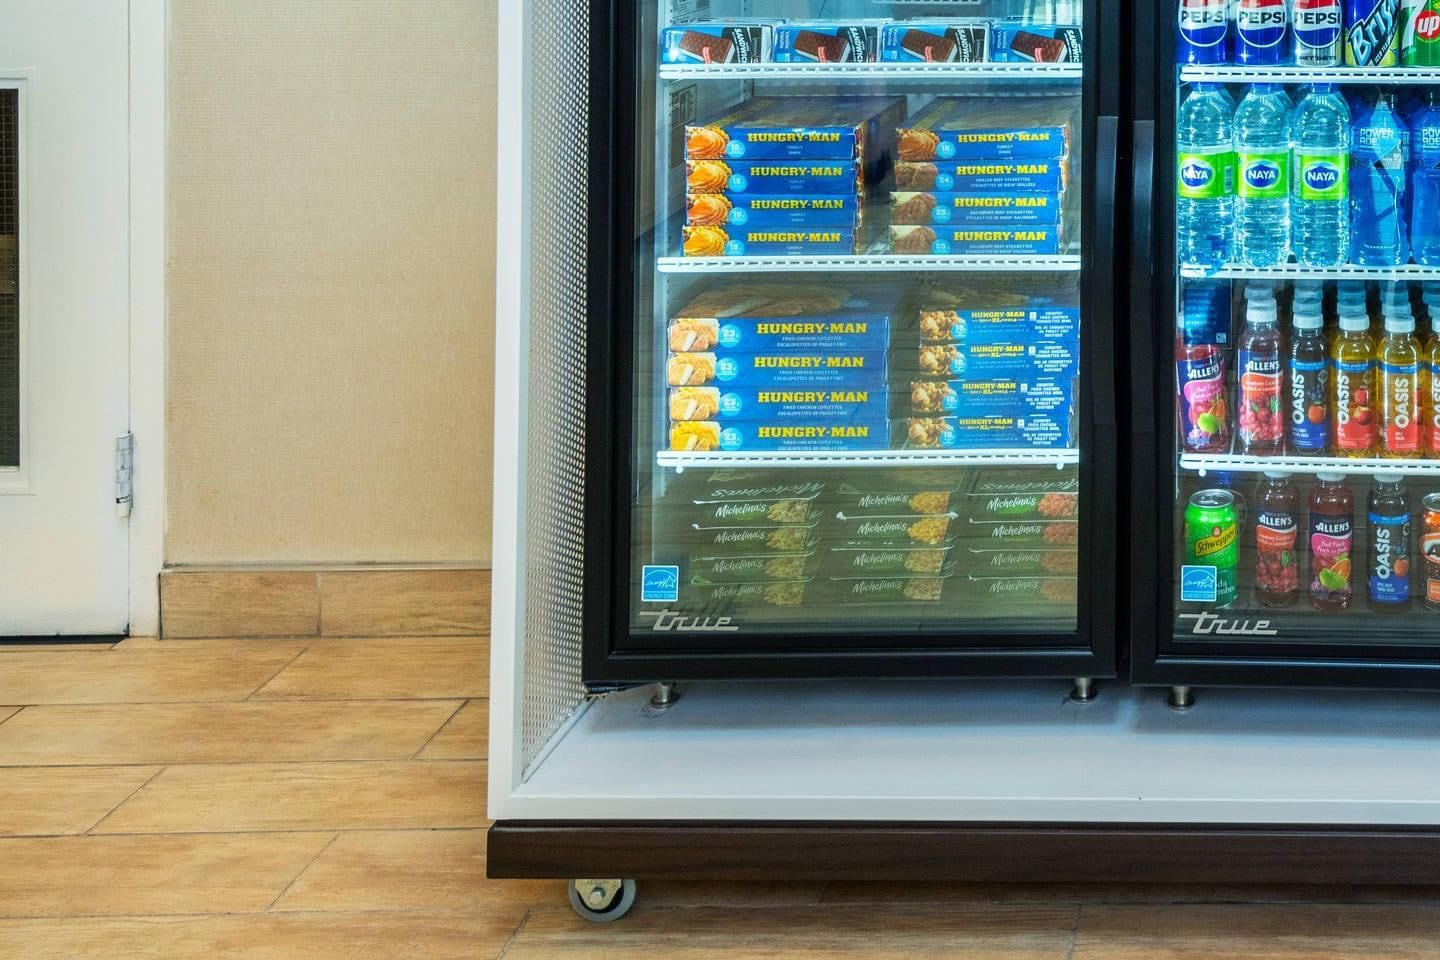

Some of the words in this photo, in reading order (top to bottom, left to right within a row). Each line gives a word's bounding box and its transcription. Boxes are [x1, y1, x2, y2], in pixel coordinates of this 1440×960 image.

[1239, 11, 1286, 24] PEPSI
[1294, 11, 1341, 25] PEPSI
[1417, 14, 1440, 36] up
[748, 132, 840, 142] HUNGRY-MAN
[957, 133, 1050, 143] HUNGRY-MAN
[1360, 128, 1395, 139] POWER
[750, 167, 842, 176] HUNGRY-MAN
[956, 165, 1048, 175] HUNGRY-MAN
[1183, 171, 1209, 180] NAYA
[1248, 170, 1276, 180] NAYA
[1307, 171, 1336, 181] NAYA
[751, 200, 843, 209] HUNGRY-MAN
[954, 197, 1048, 207] HUNGRY-MAN
[748, 233, 841, 242] HUNGRY-MAN
[953, 231, 1047, 241] HUNGRY-MAN
[971, 311, 1025, 319] HUNGRY-MAN
[757, 323, 868, 334] HUNGRY-MAN
[970, 346, 1024, 354] HUNGRY-MAN
[754, 357, 865, 368] HUNGRY-MAN
[1247, 360, 1280, 371] ALLEN'S
[757, 392, 868, 403] HUNGRY-MAN
[1291, 374, 1305, 425] OASIS
[1337, 375, 1350, 425] OASIS
[1394, 378, 1409, 429] OASIS
[758, 427, 869, 438] HUNGRY-MAN
[858, 494, 909, 509] Michelina's
[986, 496, 1037, 513] Michelina's
[716, 503, 767, 518] Michelina's
[1259, 515, 1292, 526] ALLEN'S
[857, 522, 908, 536] Michelina's
[991, 524, 1042, 539] Michelina's
[1315, 521, 1350, 533] ALLEN'S
[714, 530, 767, 545] Michelina's
[853, 551, 904, 567] Michelina's
[990, 552, 1041, 566] Michelina's
[1376, 528, 1391, 580] OASIS
[712, 559, 763, 573] Michelina's
[852, 580, 903, 594] Michelina's
[989, 579, 1039, 594] Michelina's
[711, 585, 762, 600] Michelina's
